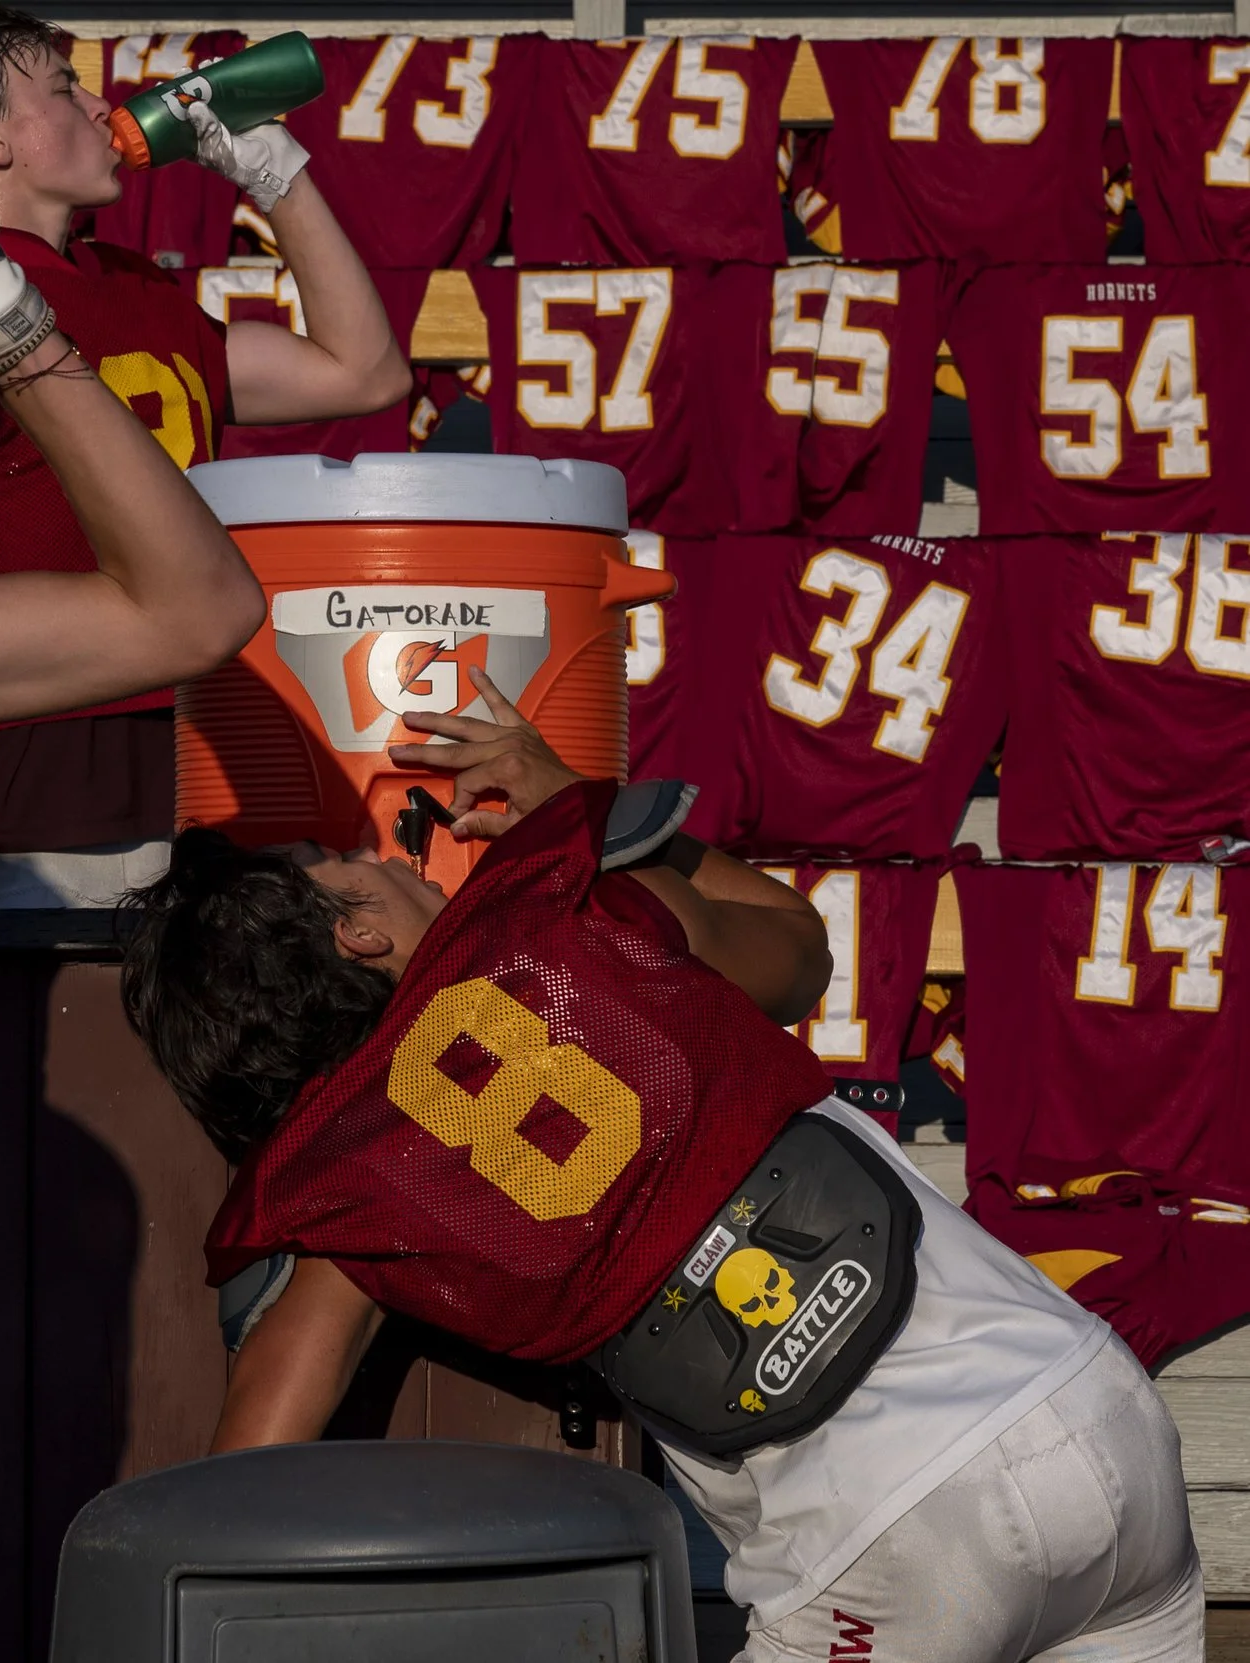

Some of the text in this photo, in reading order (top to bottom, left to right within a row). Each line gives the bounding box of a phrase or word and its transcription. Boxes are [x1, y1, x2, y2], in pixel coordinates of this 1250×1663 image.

[338, 35, 498, 148] 73
[588, 36, 755, 159] 75
[889, 37, 1046, 144] 78
[515, 267, 673, 431] 57
[765, 262, 900, 428] 55
[1086, 282, 1157, 302] HORNETS
[1039, 314, 1211, 480] 54
[326, 590, 495, 629] GATORADE
[762, 547, 971, 764] 34
[1074, 863, 1228, 1012] 14
[387, 976, 641, 1222] 8
[690, 1233, 727, 1279] CLAW
[765, 1269, 856, 1381] BATTLE
